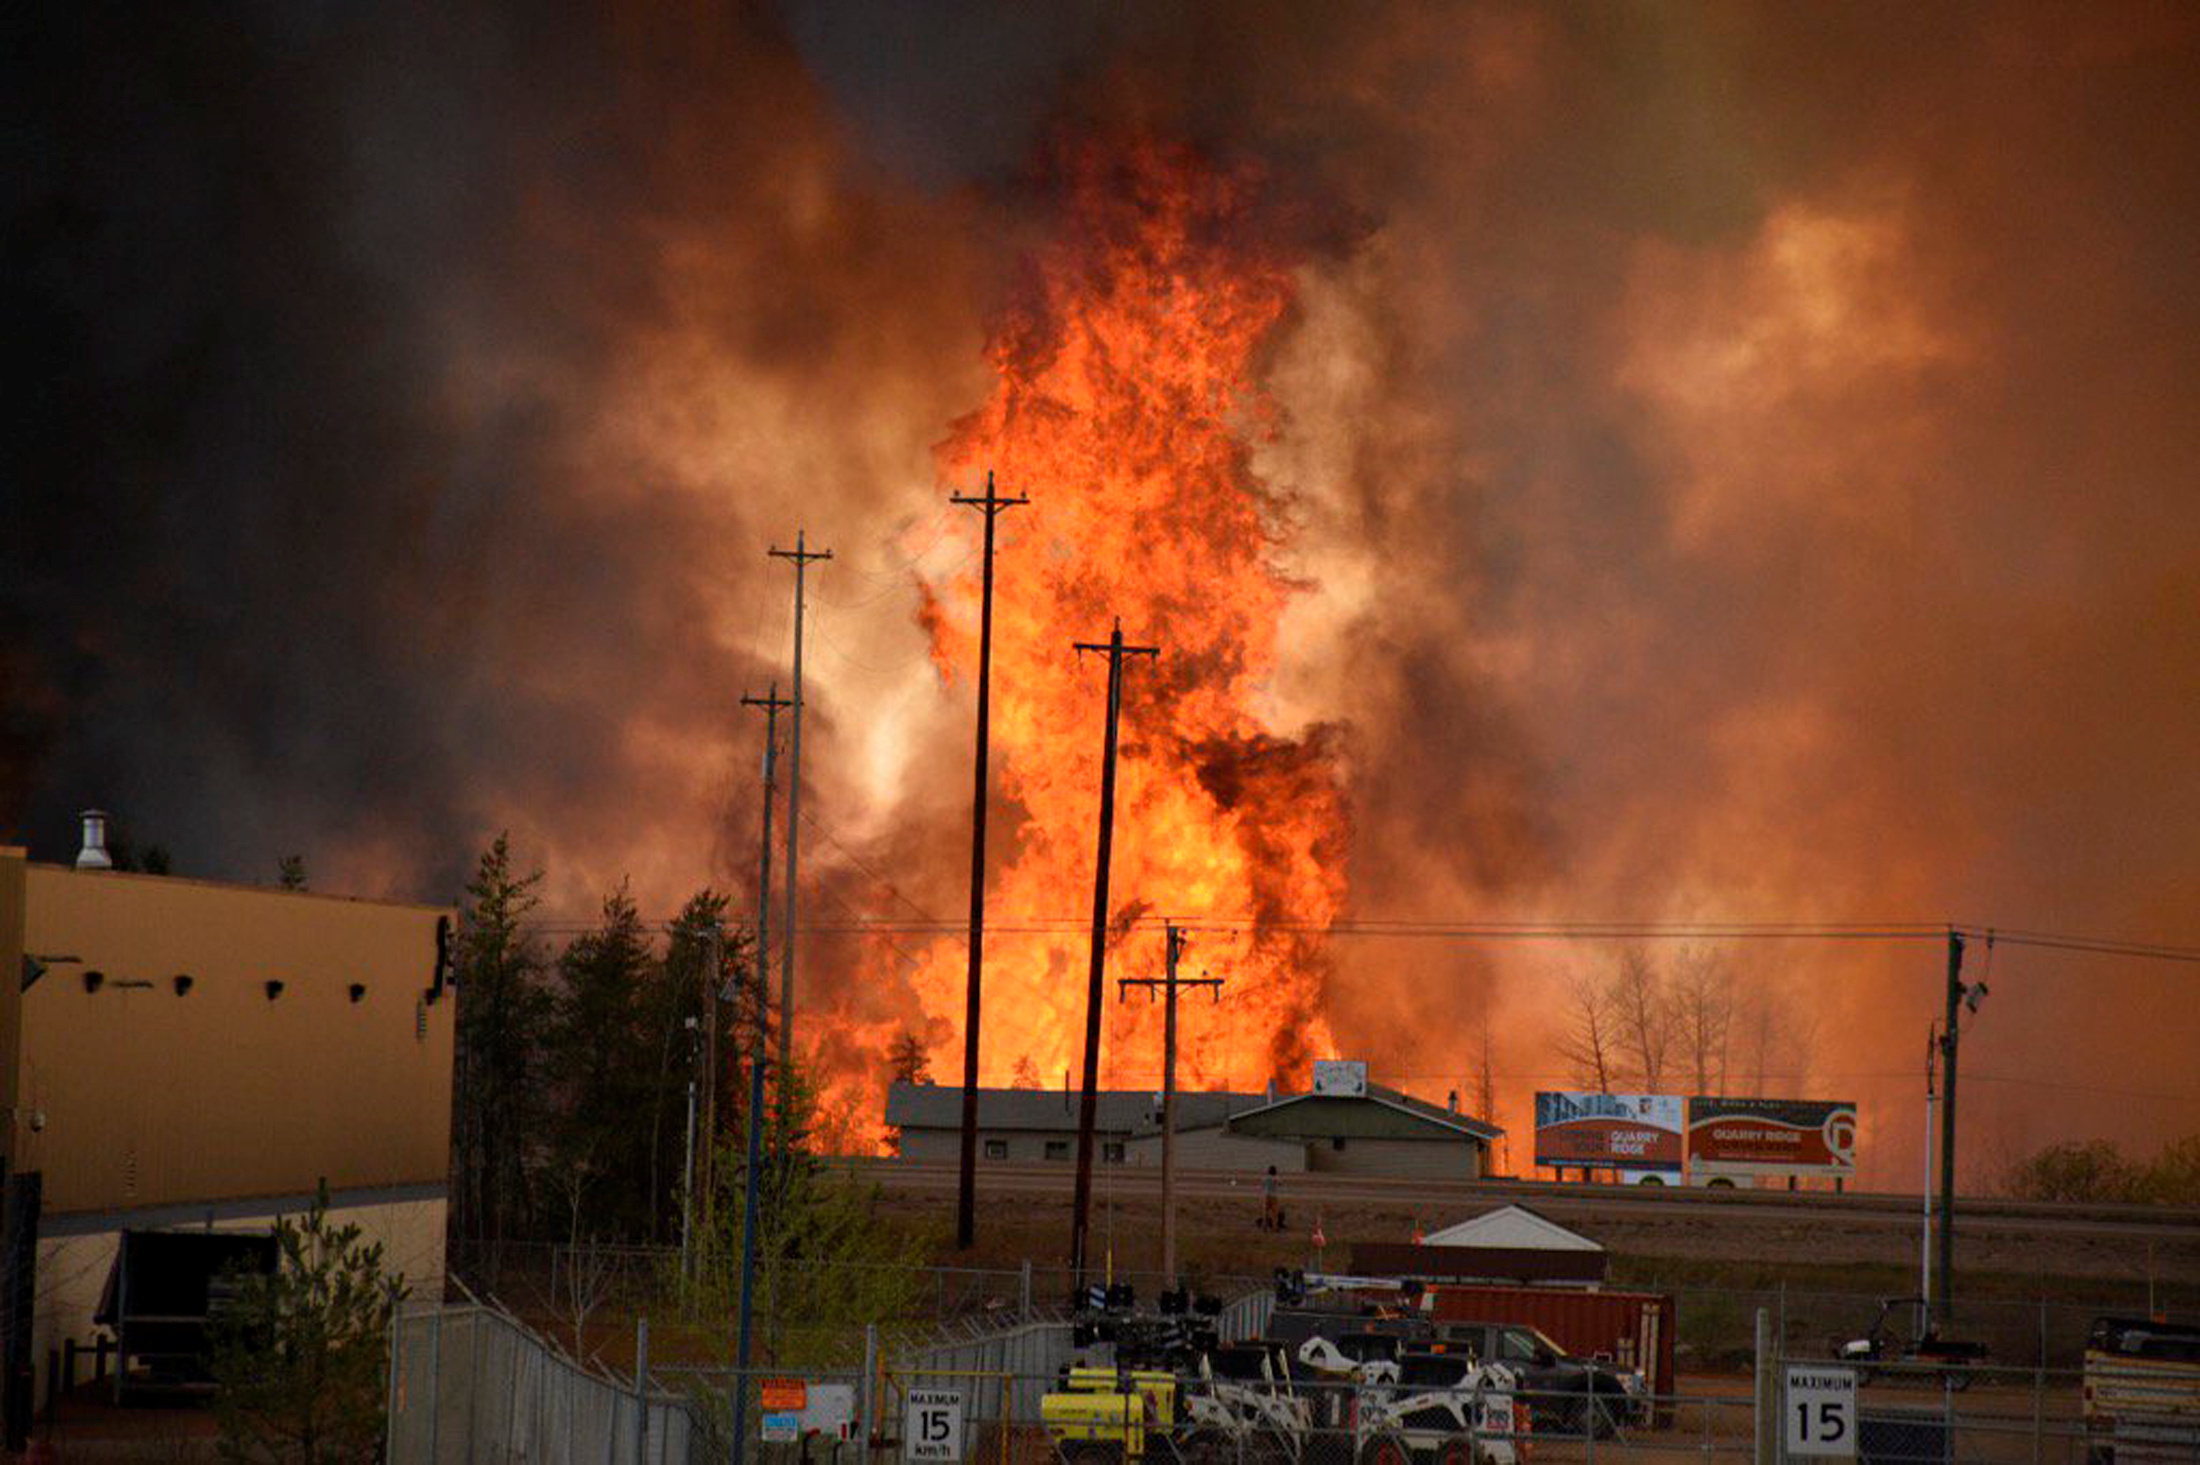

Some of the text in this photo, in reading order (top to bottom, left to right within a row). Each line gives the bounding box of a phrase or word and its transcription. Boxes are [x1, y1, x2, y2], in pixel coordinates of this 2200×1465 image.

[1610, 1130, 1659, 1143] QUARRY
[1712, 1128, 1762, 1140] QUARRY
[1790, 1375, 1852, 1391] MAXIMUM
[910, 1393, 959, 1405] MAXIMUM
[921, 1411, 950, 1441] 15
[1798, 1403, 1845, 1441] 15
